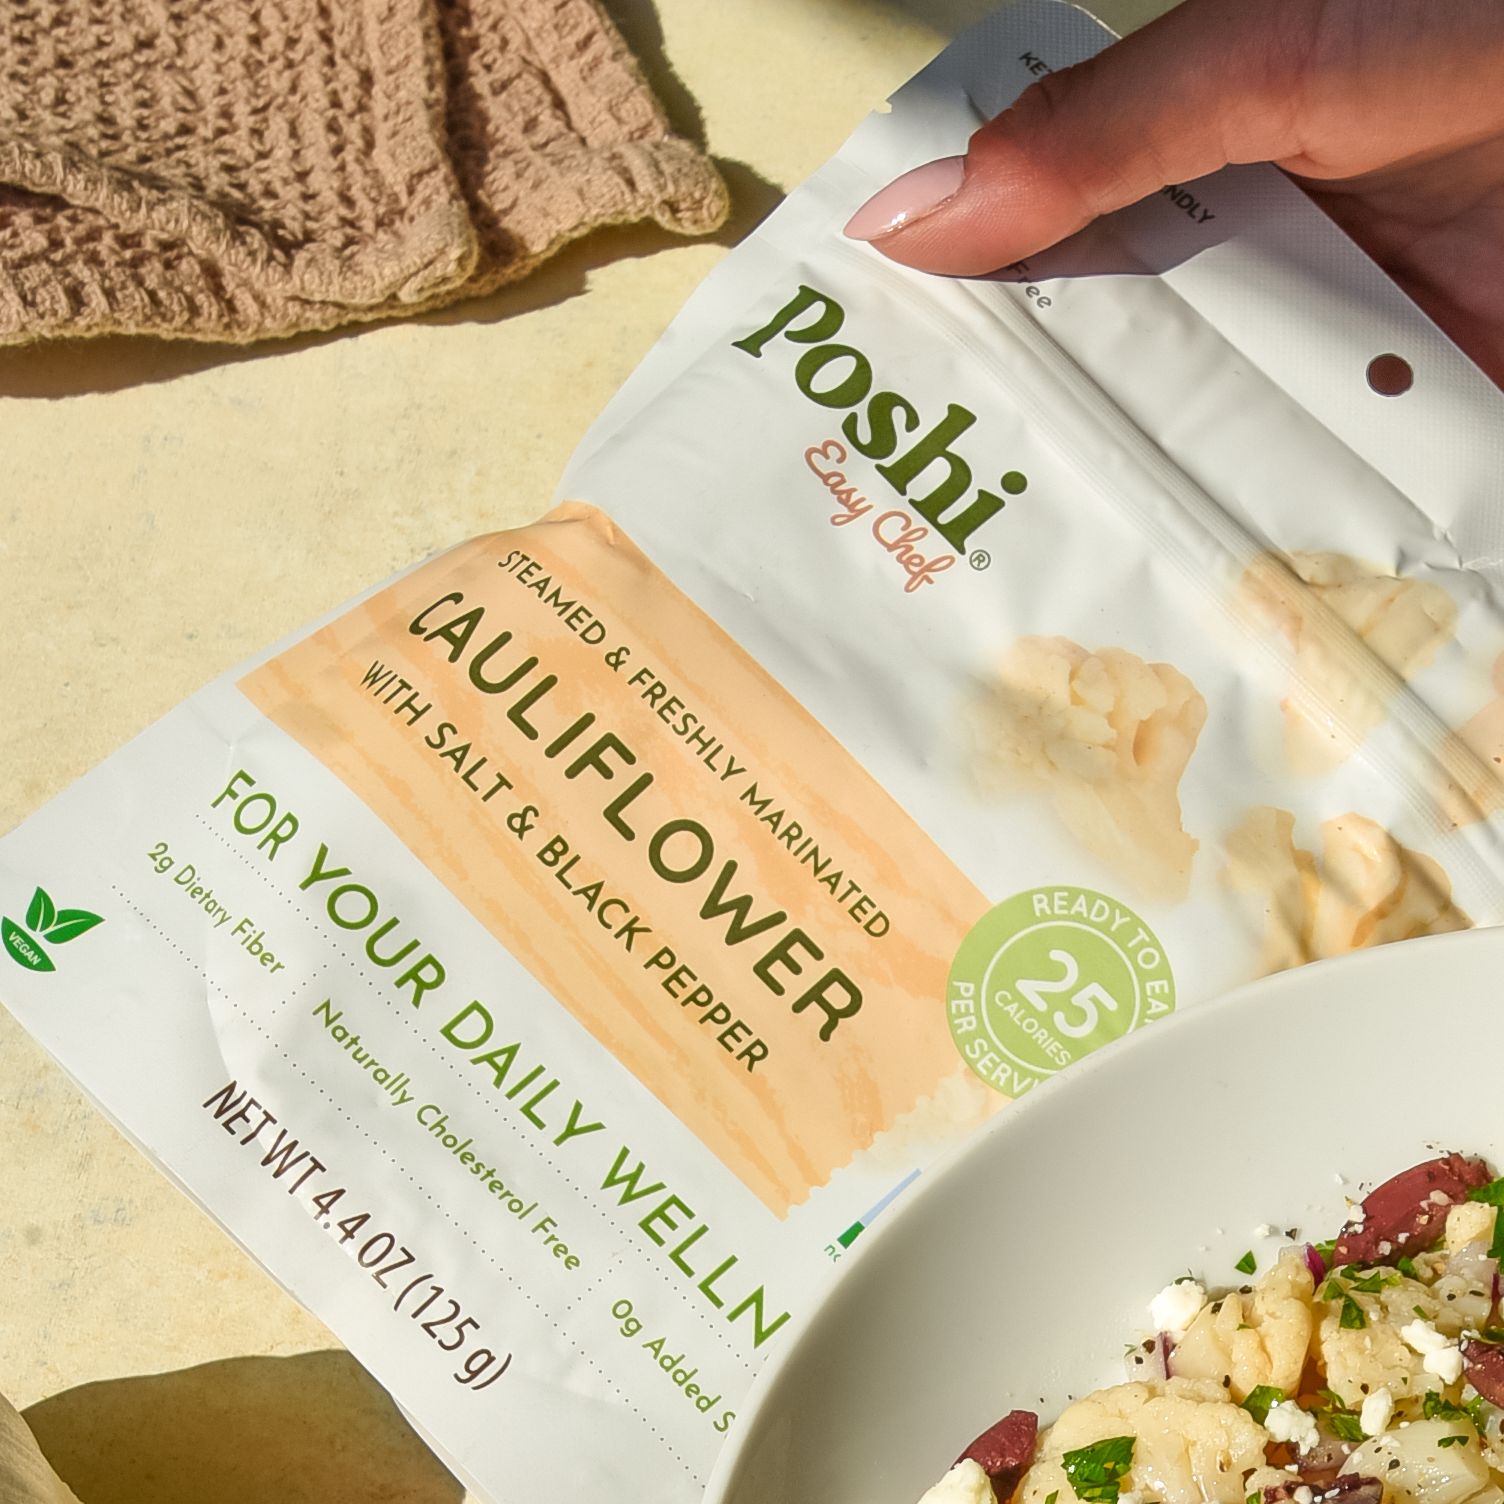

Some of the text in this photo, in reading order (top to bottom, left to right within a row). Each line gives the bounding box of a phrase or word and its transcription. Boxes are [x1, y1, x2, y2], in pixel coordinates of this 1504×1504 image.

[1019, 52, 1053, 76] KE
[1162, 185, 1215, 224] NDLY
[805, 439, 956, 593] Easy Chef
[497, 550, 890, 938] STEAMED & FRESHLY MARINATED
[360, 660, 769, 1073] WITH SALT & BLACK PEPPER
[408, 591, 863, 1042] CAULIFLOWER
[8, 931, 41, 965] VEGAN
[147, 842, 285, 974] 2g Dietary Fiber
[1032, 891, 1168, 1023] READY TO EA
[210, 769, 792, 1349] FOR YOUR DAILY WELLN
[951, 980, 978, 1034] PER
[994, 990, 1071, 1066] CALORIES
[1015, 949, 1118, 1038] 25
[202, 1080, 278, 1146] NET
[260, 1128, 327, 1195] WT
[312, 1188, 371, 1244] 4.4
[357, 1232, 416, 1289] OZ
[312, 998, 581, 1270] Naturally Cholesterol Free
[642, 1336, 722, 1413] Added
